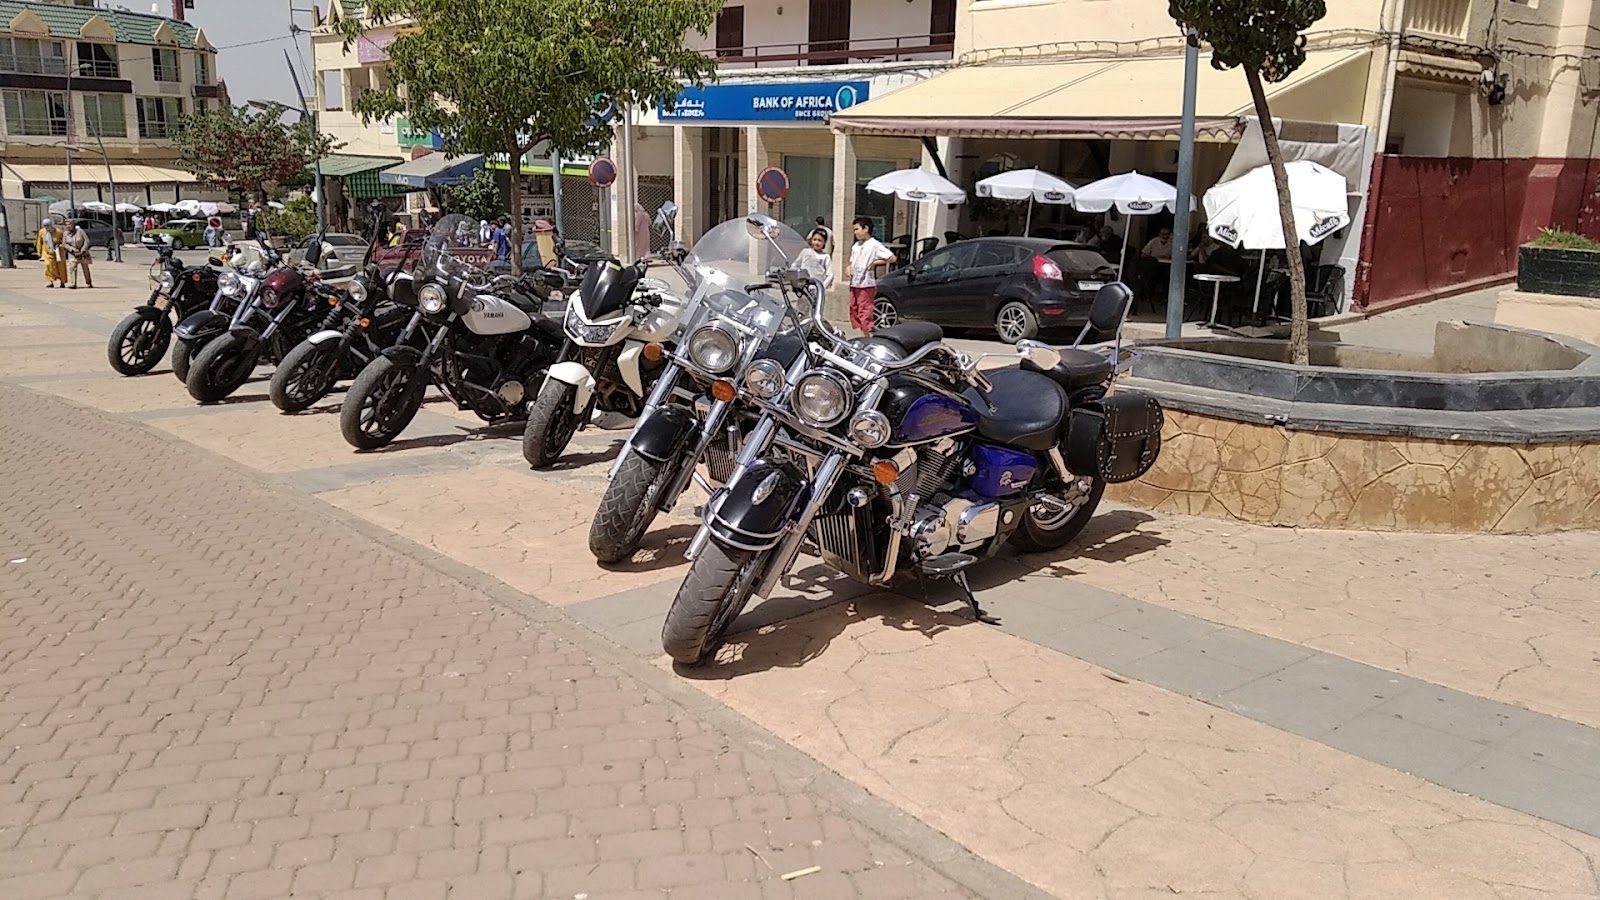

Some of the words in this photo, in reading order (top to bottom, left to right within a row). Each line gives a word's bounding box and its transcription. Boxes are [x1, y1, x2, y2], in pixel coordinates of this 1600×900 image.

[752, 97, 780, 108] BANK
[780, 97, 795, 108] OF
[795, 96, 834, 108] AFRICA
